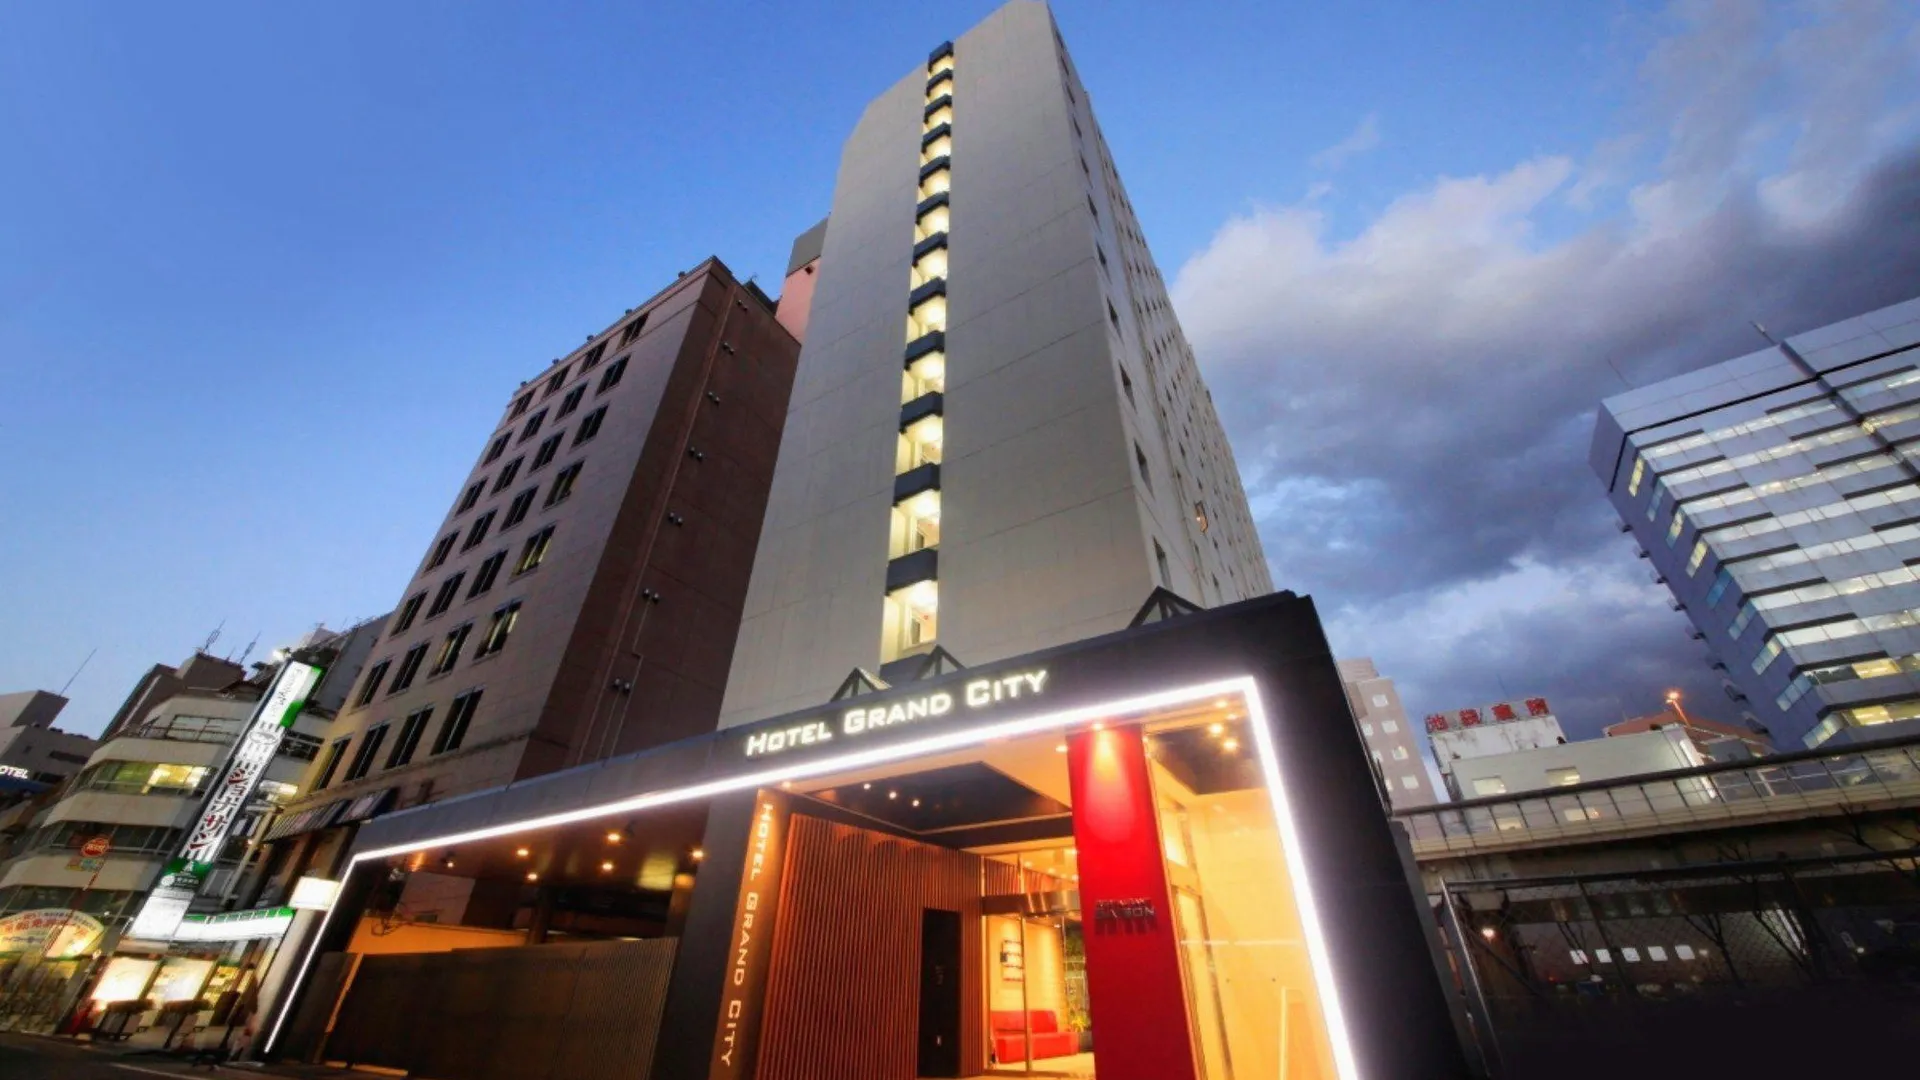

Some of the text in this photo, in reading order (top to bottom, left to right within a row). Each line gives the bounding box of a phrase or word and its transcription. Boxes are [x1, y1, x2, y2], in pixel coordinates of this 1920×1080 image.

[746, 670, 1047, 756] HOTEL GRAND CITY
[721, 803, 774, 1067] HOTEL GRAND CITY
